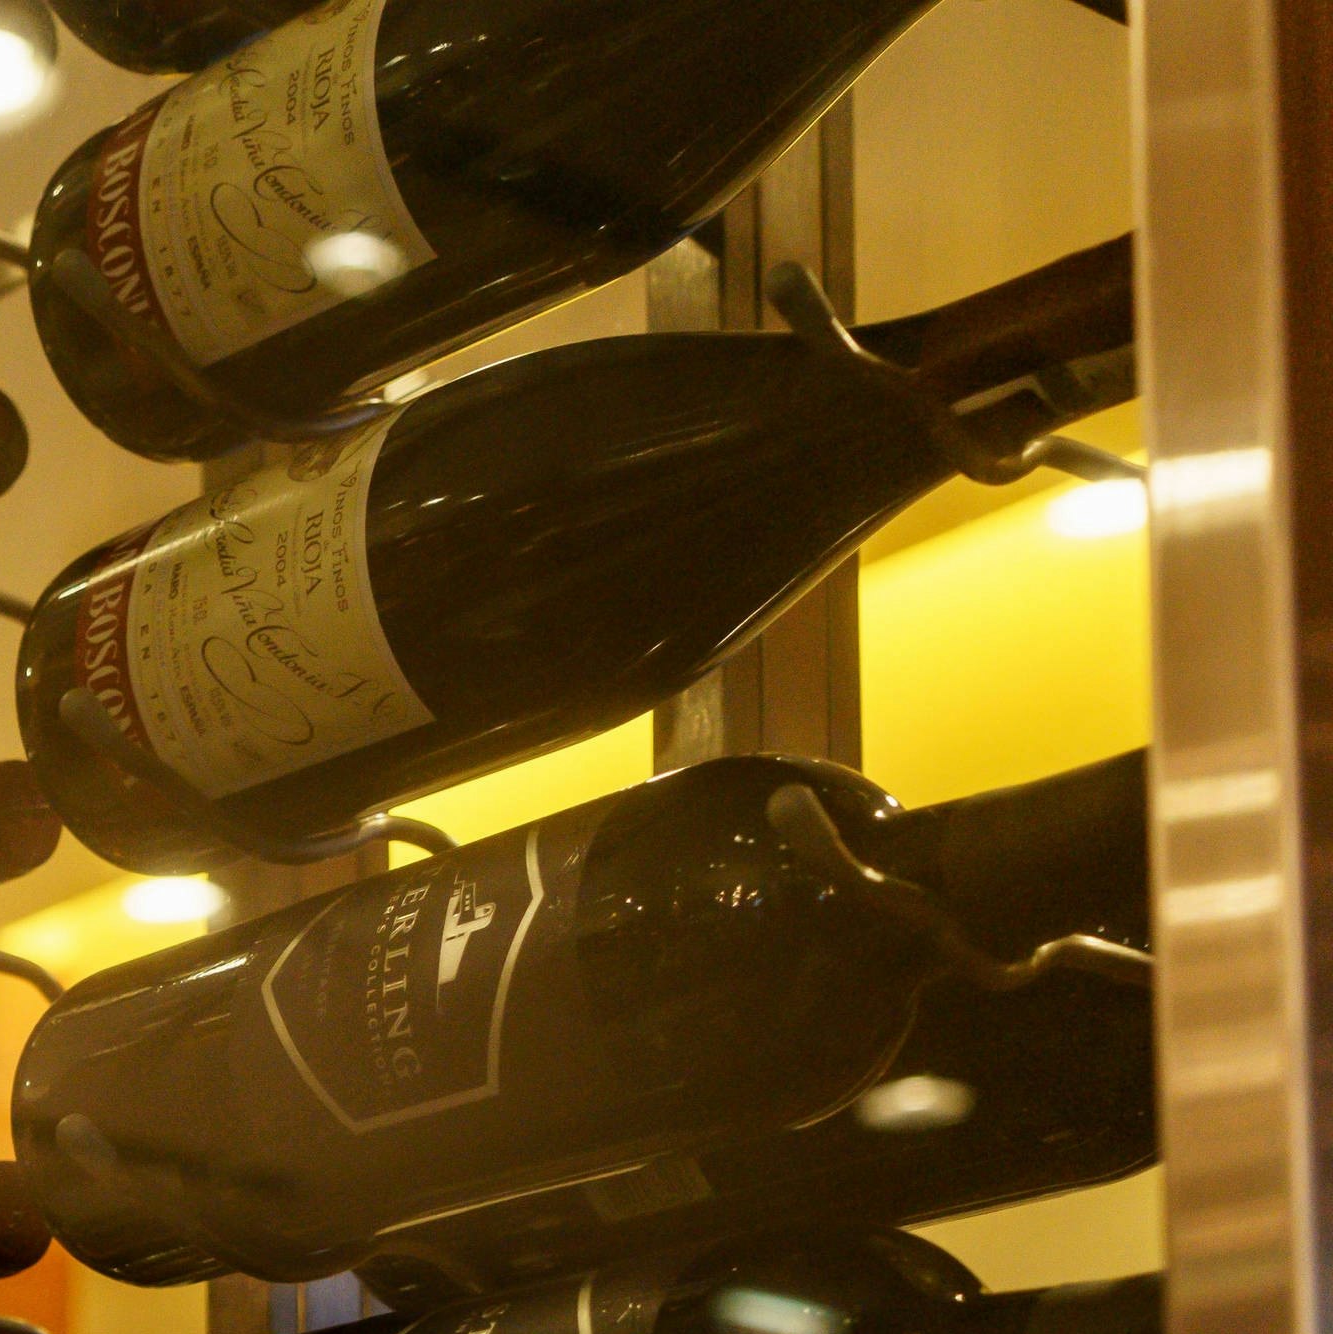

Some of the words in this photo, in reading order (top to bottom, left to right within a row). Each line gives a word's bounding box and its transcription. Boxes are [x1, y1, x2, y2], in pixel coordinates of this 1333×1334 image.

[286, 70, 299, 126] 2004
[310, 48, 335, 131] RIOJA
[340, 73, 357, 145] FINOS
[96, 142, 149, 315] BOSCONI
[333, 460, 362, 538] VINOS
[275, 531, 289, 587] 2004
[301, 509, 325, 595] RIOJA
[333, 542, 349, 612] FINOS
[383, 884, 431, 1080] ERLING
